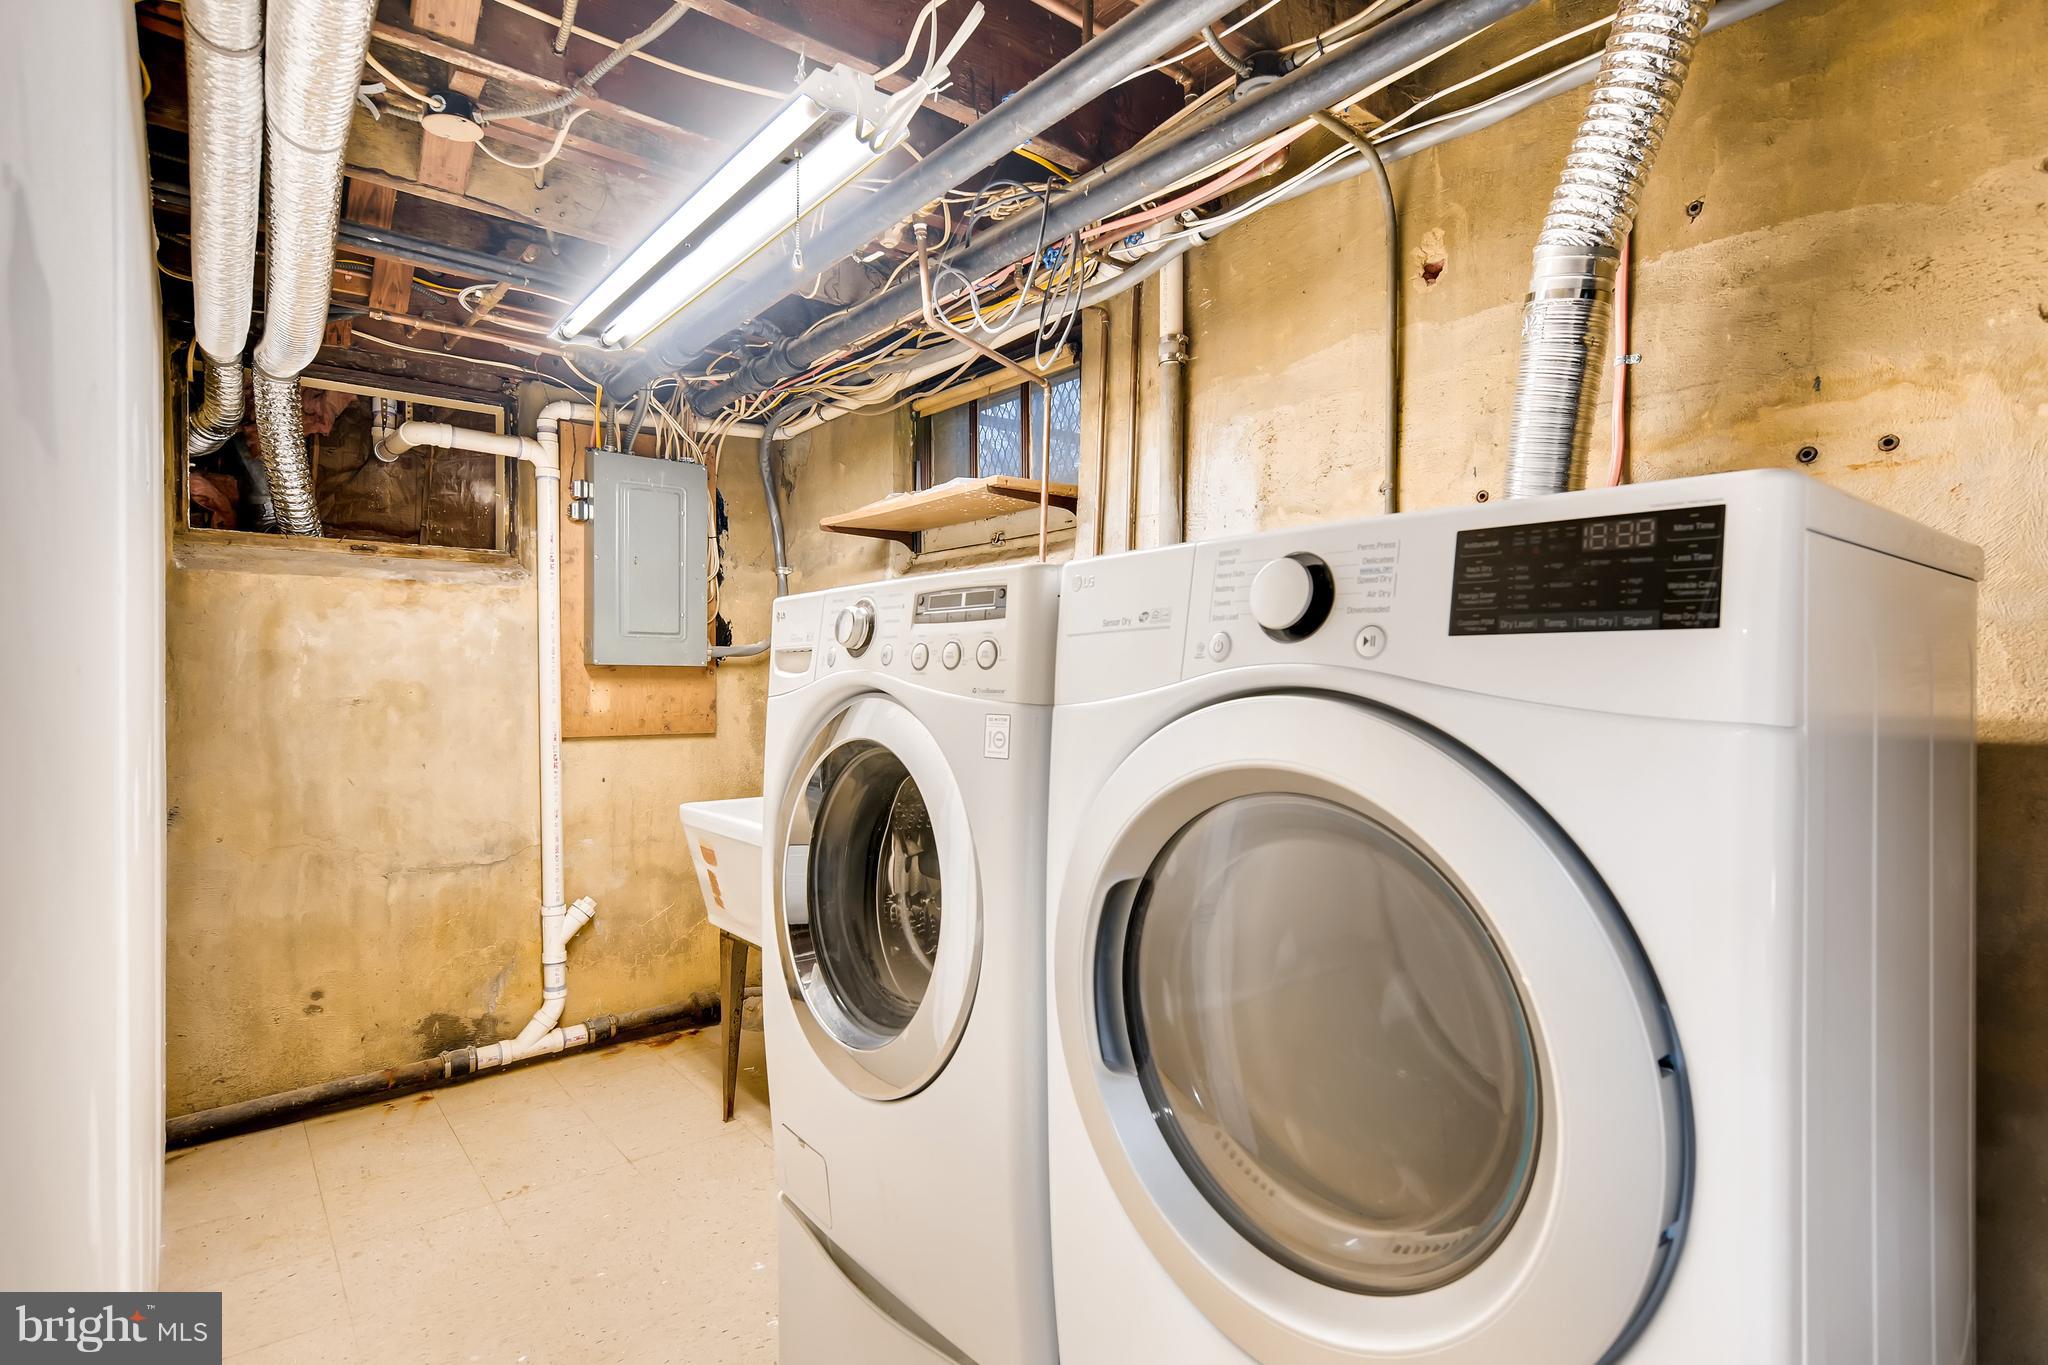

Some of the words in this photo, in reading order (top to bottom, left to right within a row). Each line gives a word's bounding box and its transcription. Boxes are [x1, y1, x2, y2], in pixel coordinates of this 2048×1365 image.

[1380, 575, 1393, 583] Dry
[1378, 590, 1391, 598] Dry
[1102, 619, 1120, 628] Sensor
[1121, 617, 1132, 626] Dry
[1500, 620, 1513, 630] Dry
[1514, 620, 1534, 629] Level
[1578, 617, 1597, 627] Time
[1598, 617, 1614, 627] Dry
[1623, 615, 1653, 626] Signal
